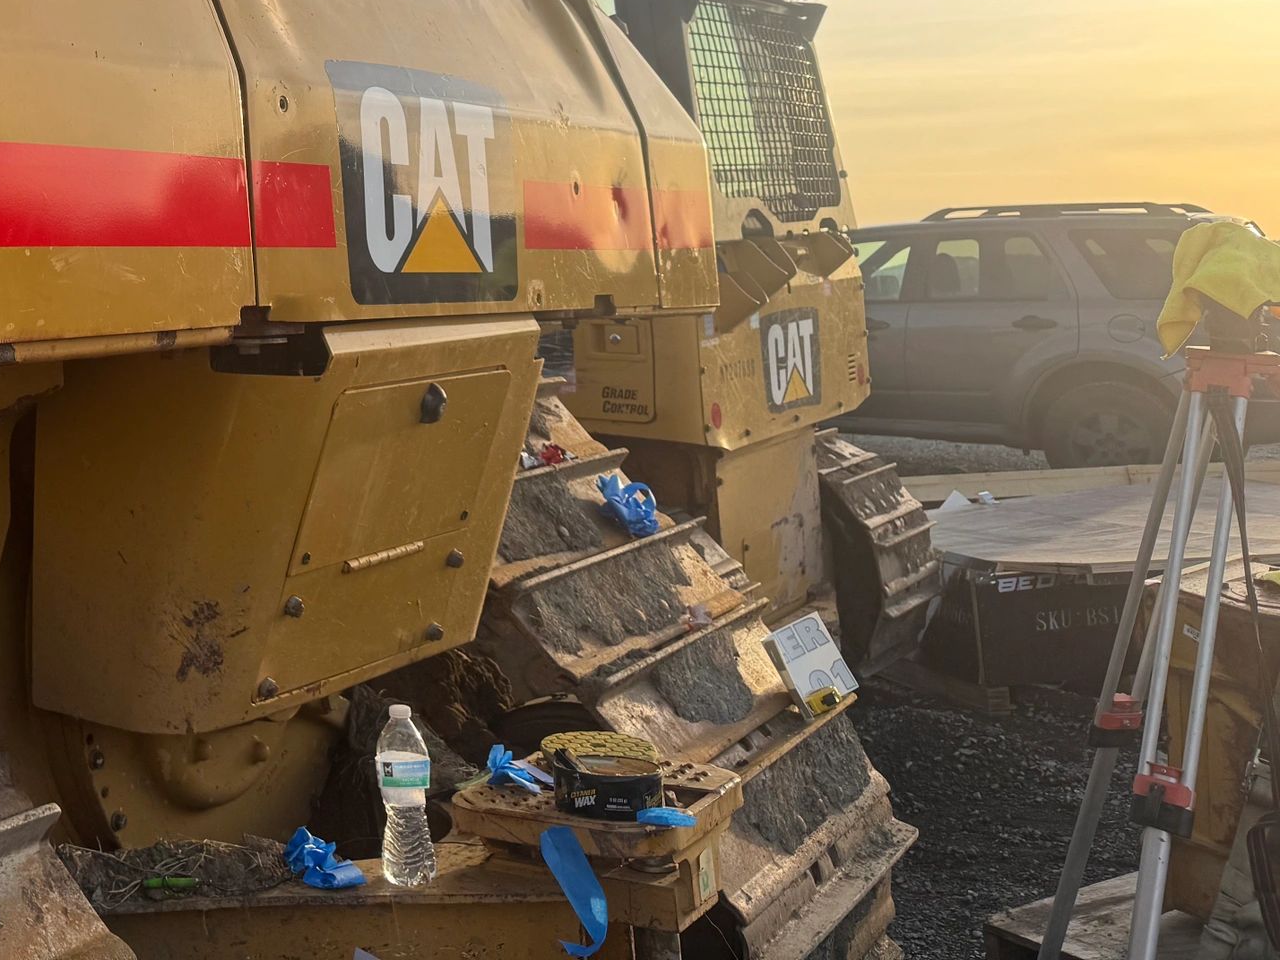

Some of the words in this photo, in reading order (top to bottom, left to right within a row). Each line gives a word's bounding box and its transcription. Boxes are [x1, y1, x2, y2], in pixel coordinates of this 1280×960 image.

[360, 86, 495, 273] CAT
[767, 318, 814, 406] CAT
[602, 386, 637, 401] GRADE
[602, 400, 650, 416] CONTROL
[775, 616, 830, 664] ER
[574, 795, 597, 809] WAX
